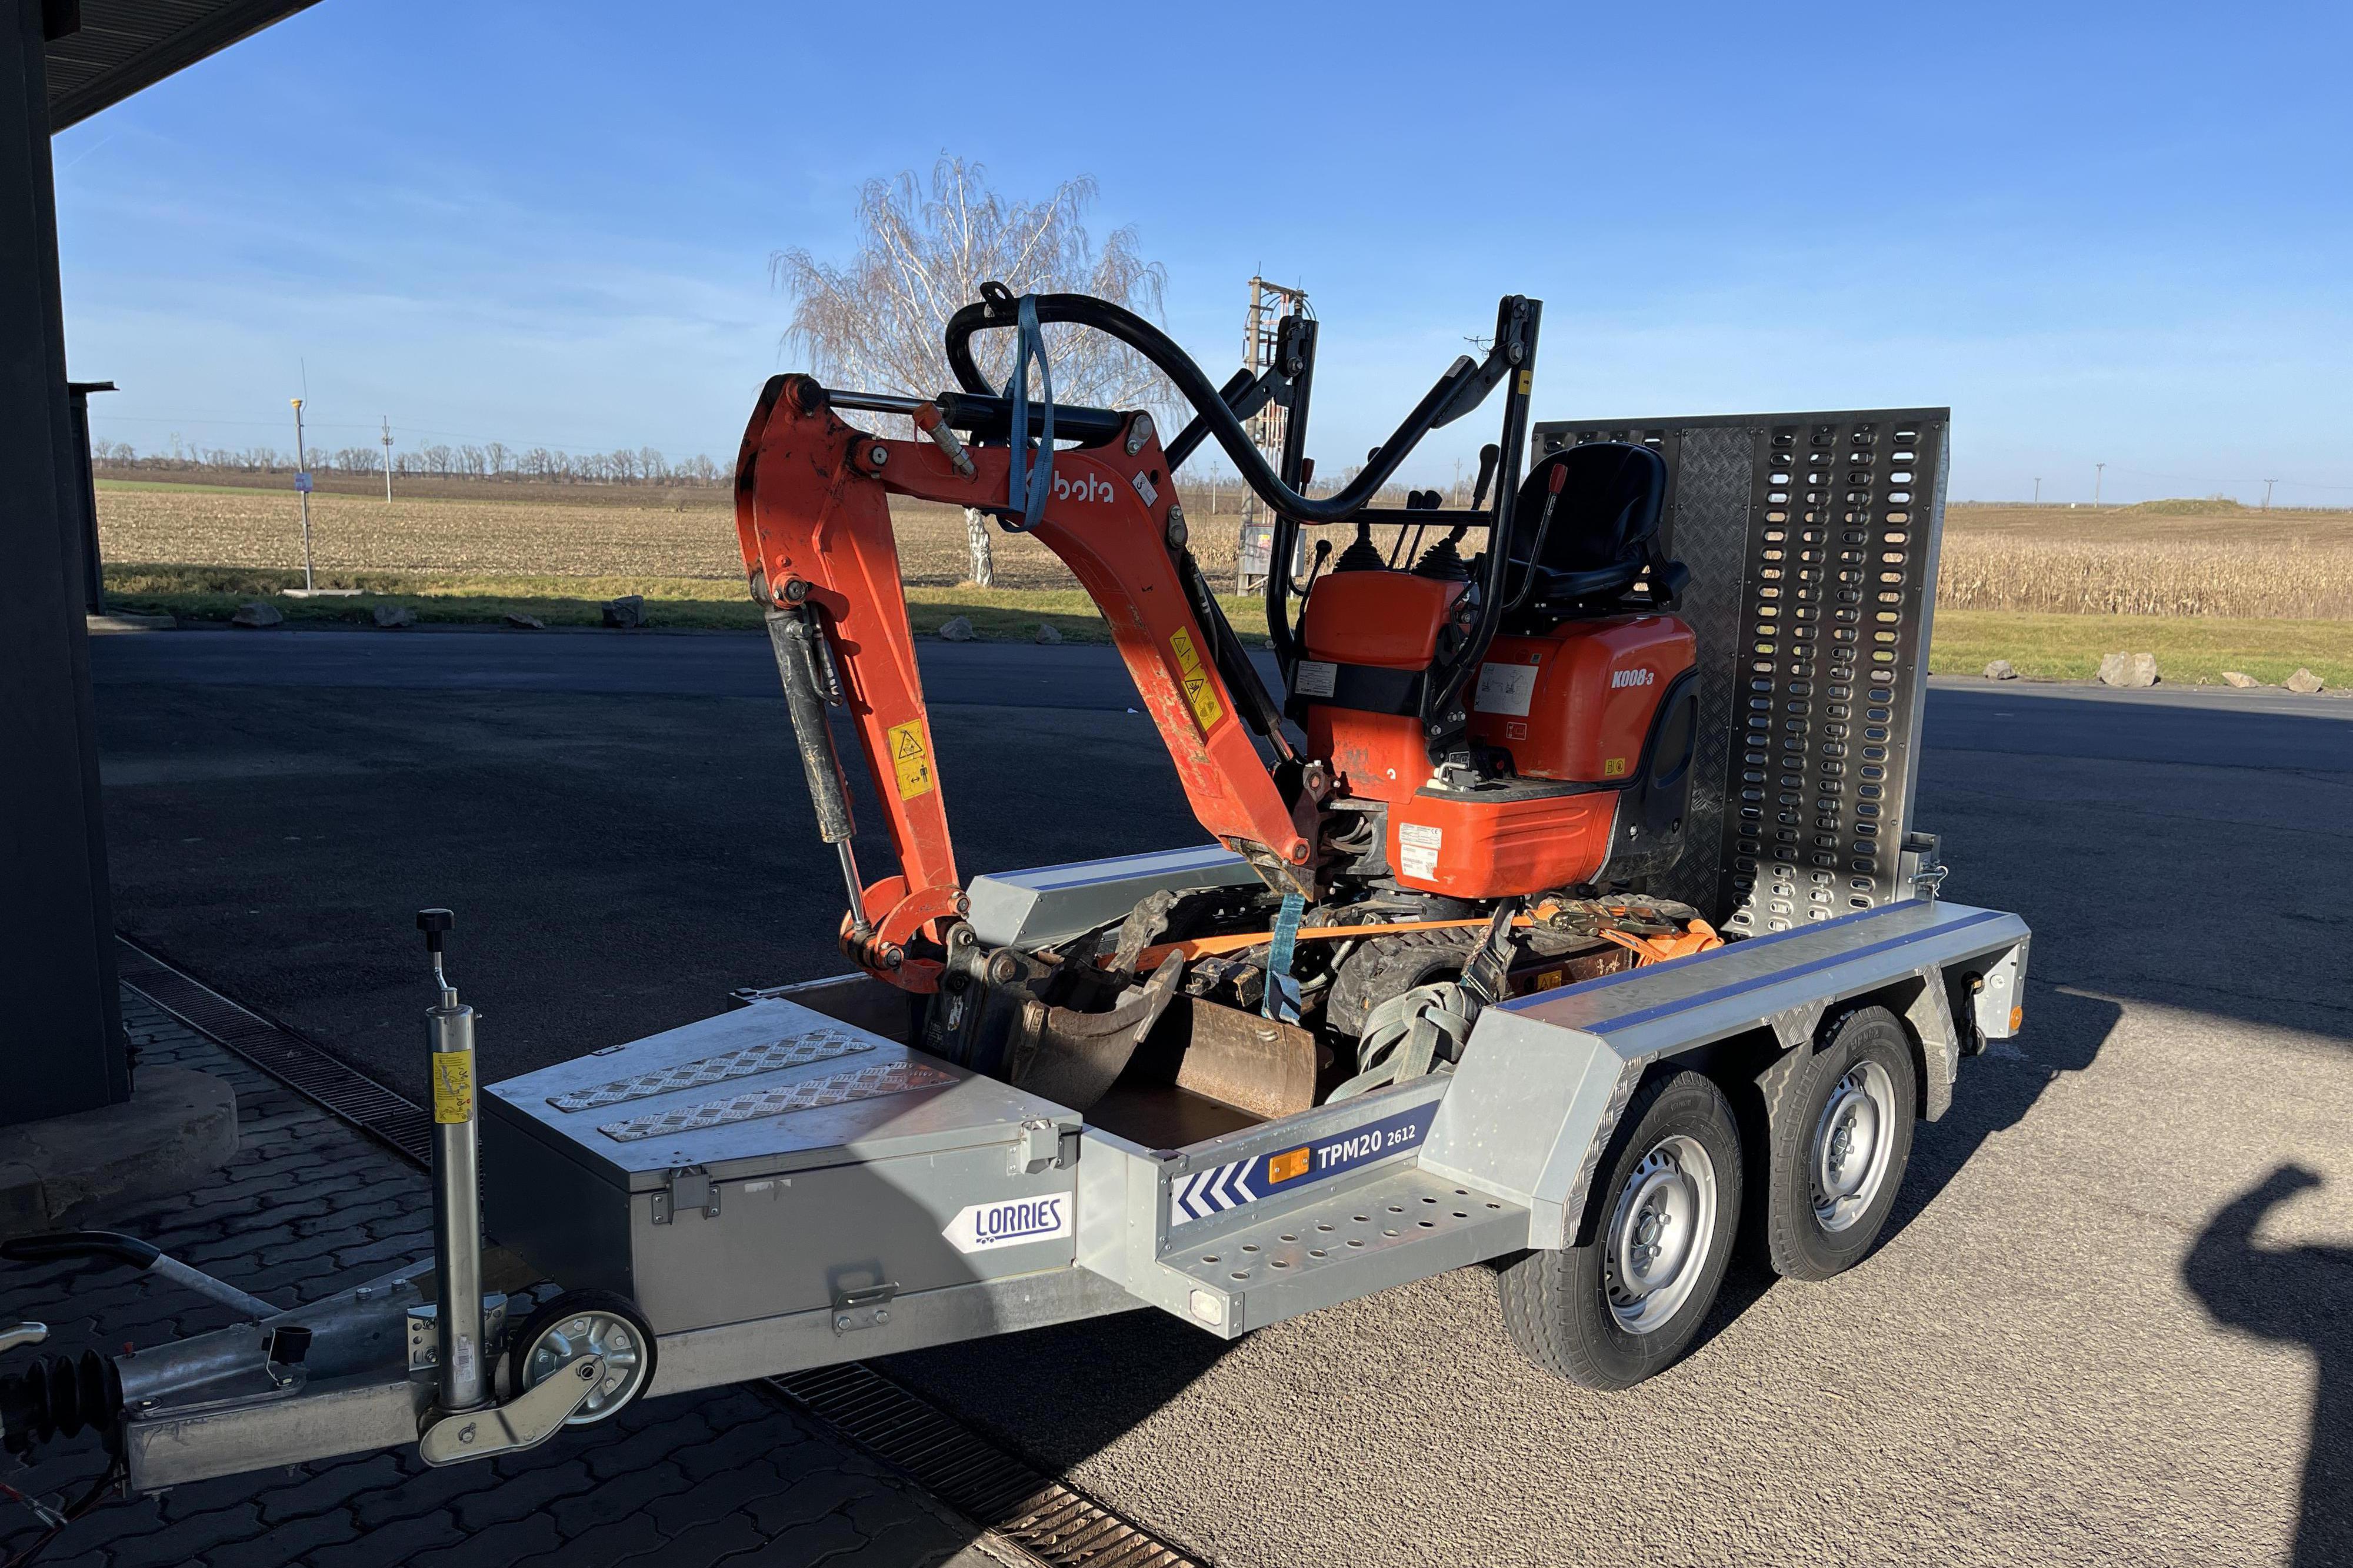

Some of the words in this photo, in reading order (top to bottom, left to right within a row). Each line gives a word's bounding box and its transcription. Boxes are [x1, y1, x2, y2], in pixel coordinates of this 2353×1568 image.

[1611, 668, 1654, 688] K008-3
[1318, 1130, 1382, 1169] TPM20
[1387, 1125, 1415, 1146] 2612
[976, 1199, 1061, 1236] LORRIES
